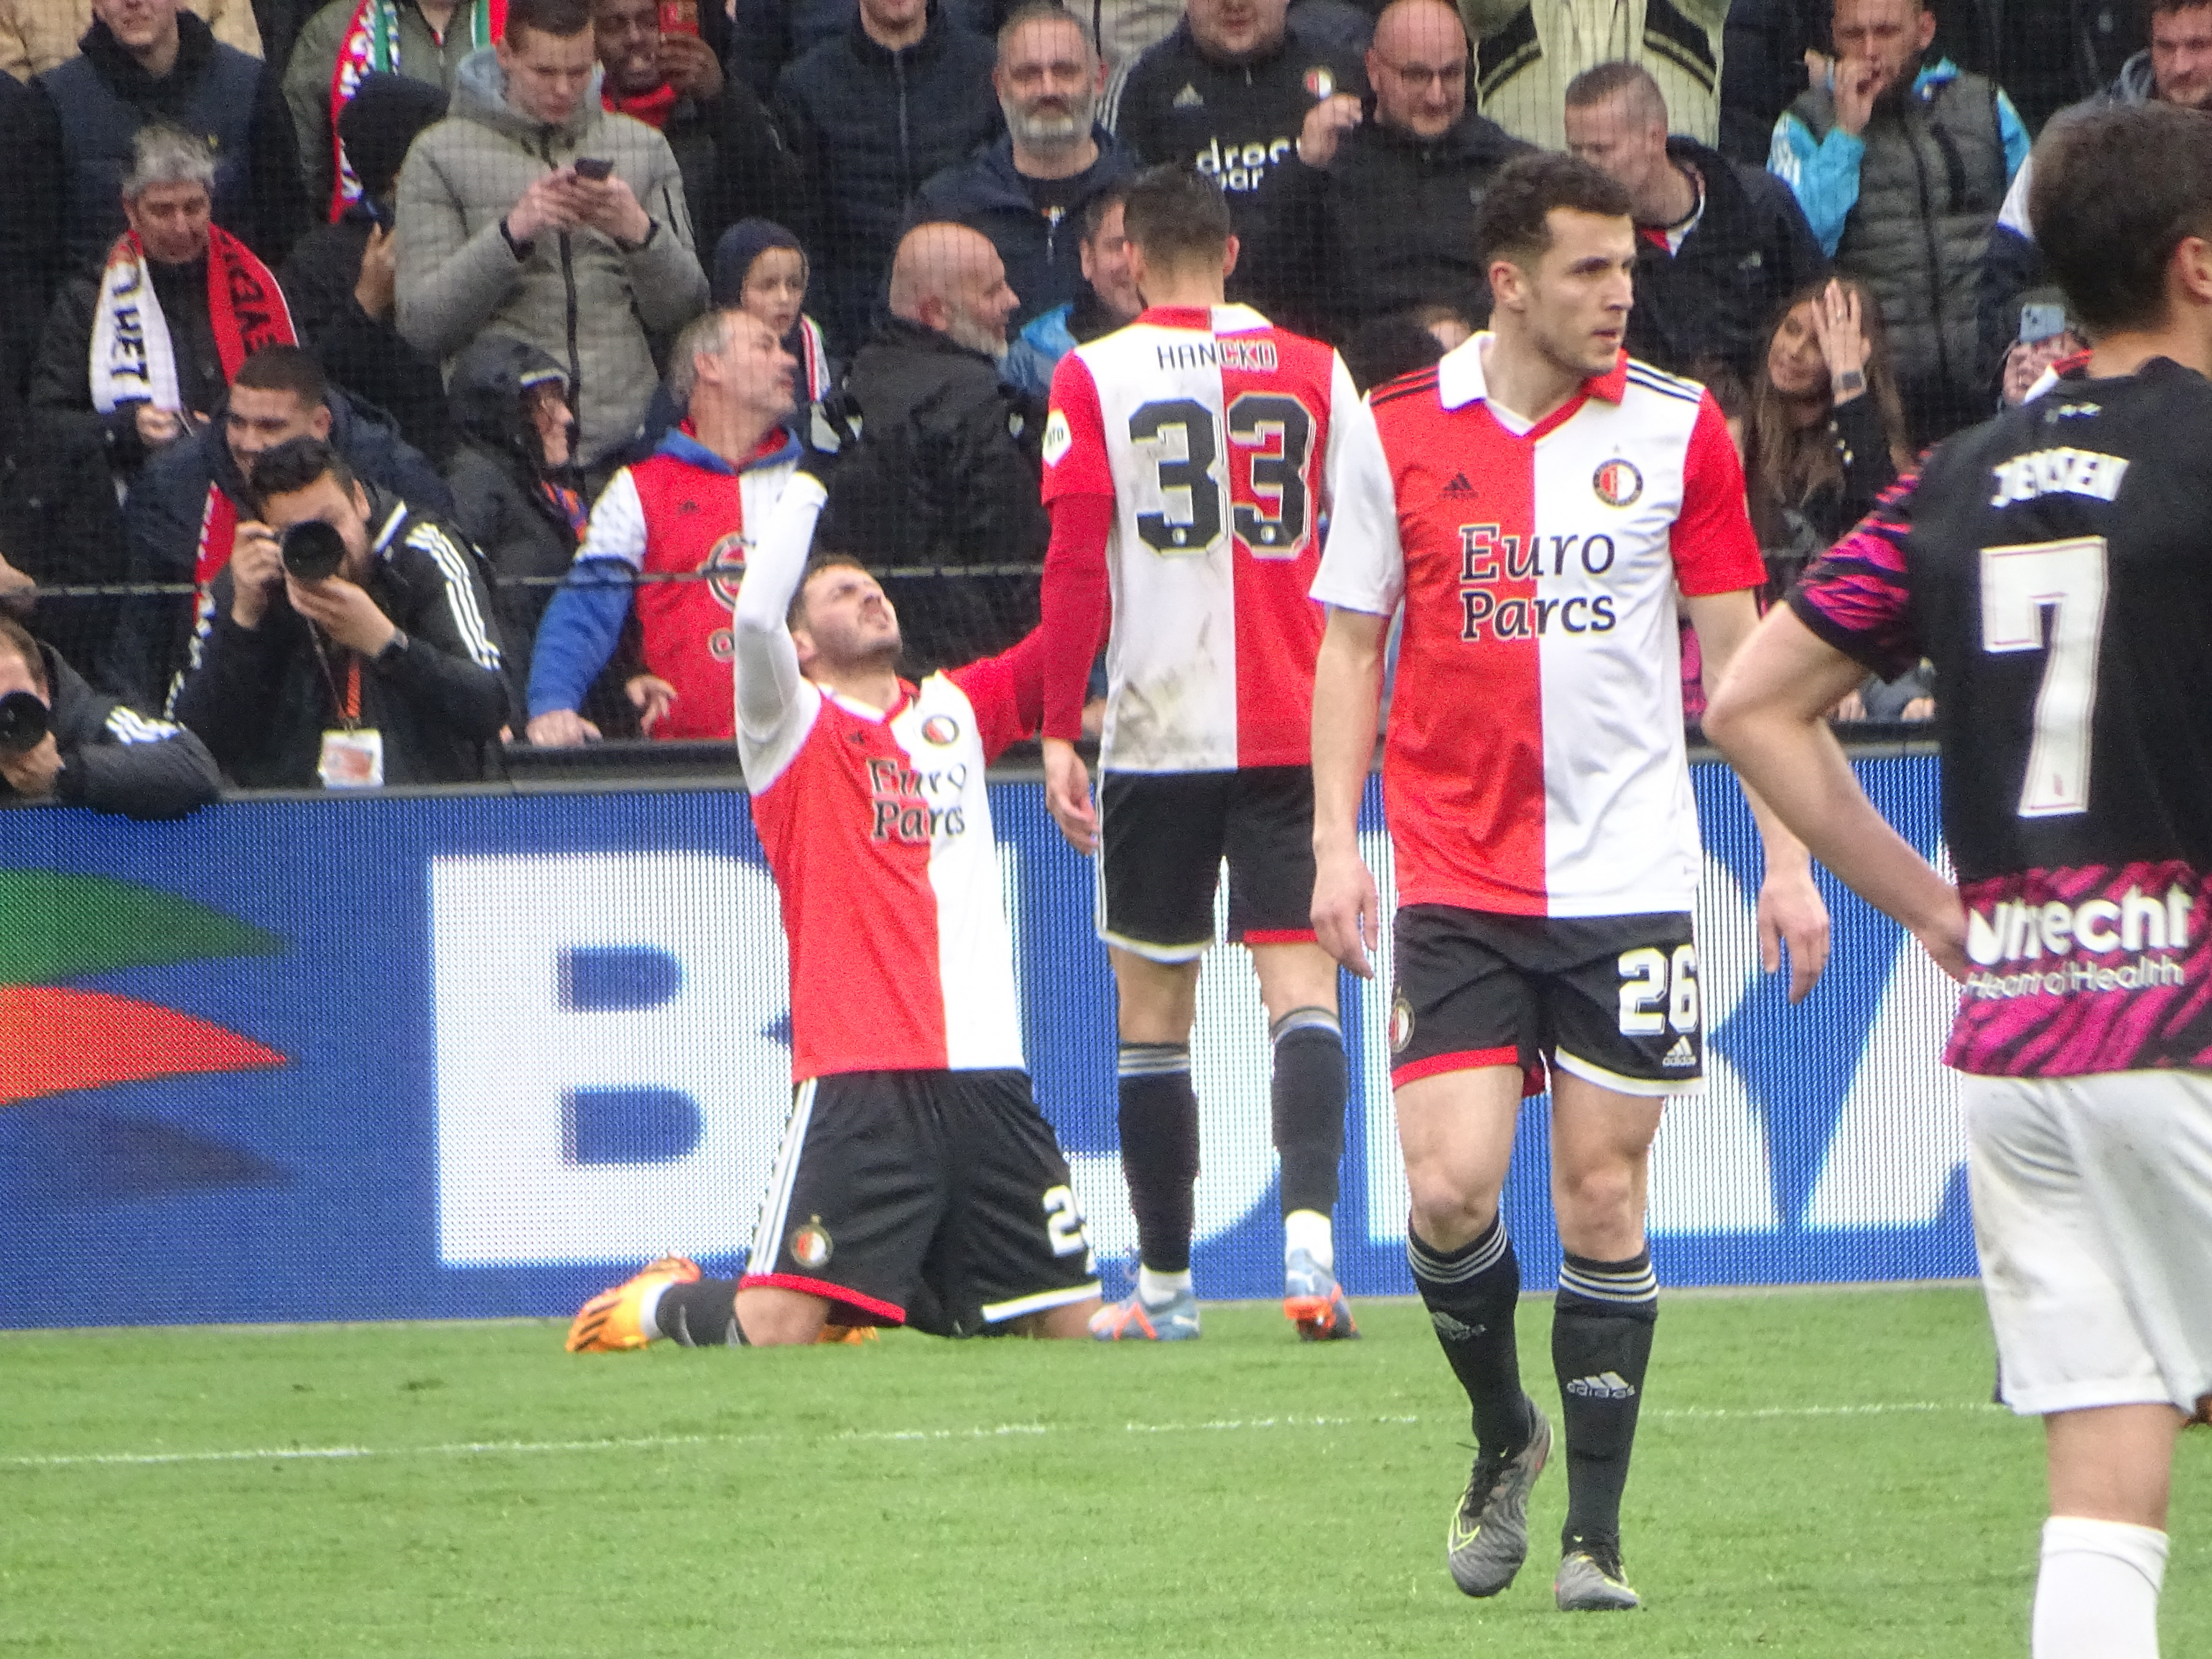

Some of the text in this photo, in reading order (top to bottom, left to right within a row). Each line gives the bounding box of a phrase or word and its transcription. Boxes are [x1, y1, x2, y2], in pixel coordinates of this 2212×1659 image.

[1127, 392, 1317, 561] 33
[1459, 522, 1616, 583] Euro
[1460, 588, 1618, 641] Parcs
[1980, 535, 2109, 818] 7
[1618, 943, 1699, 1036] 26
